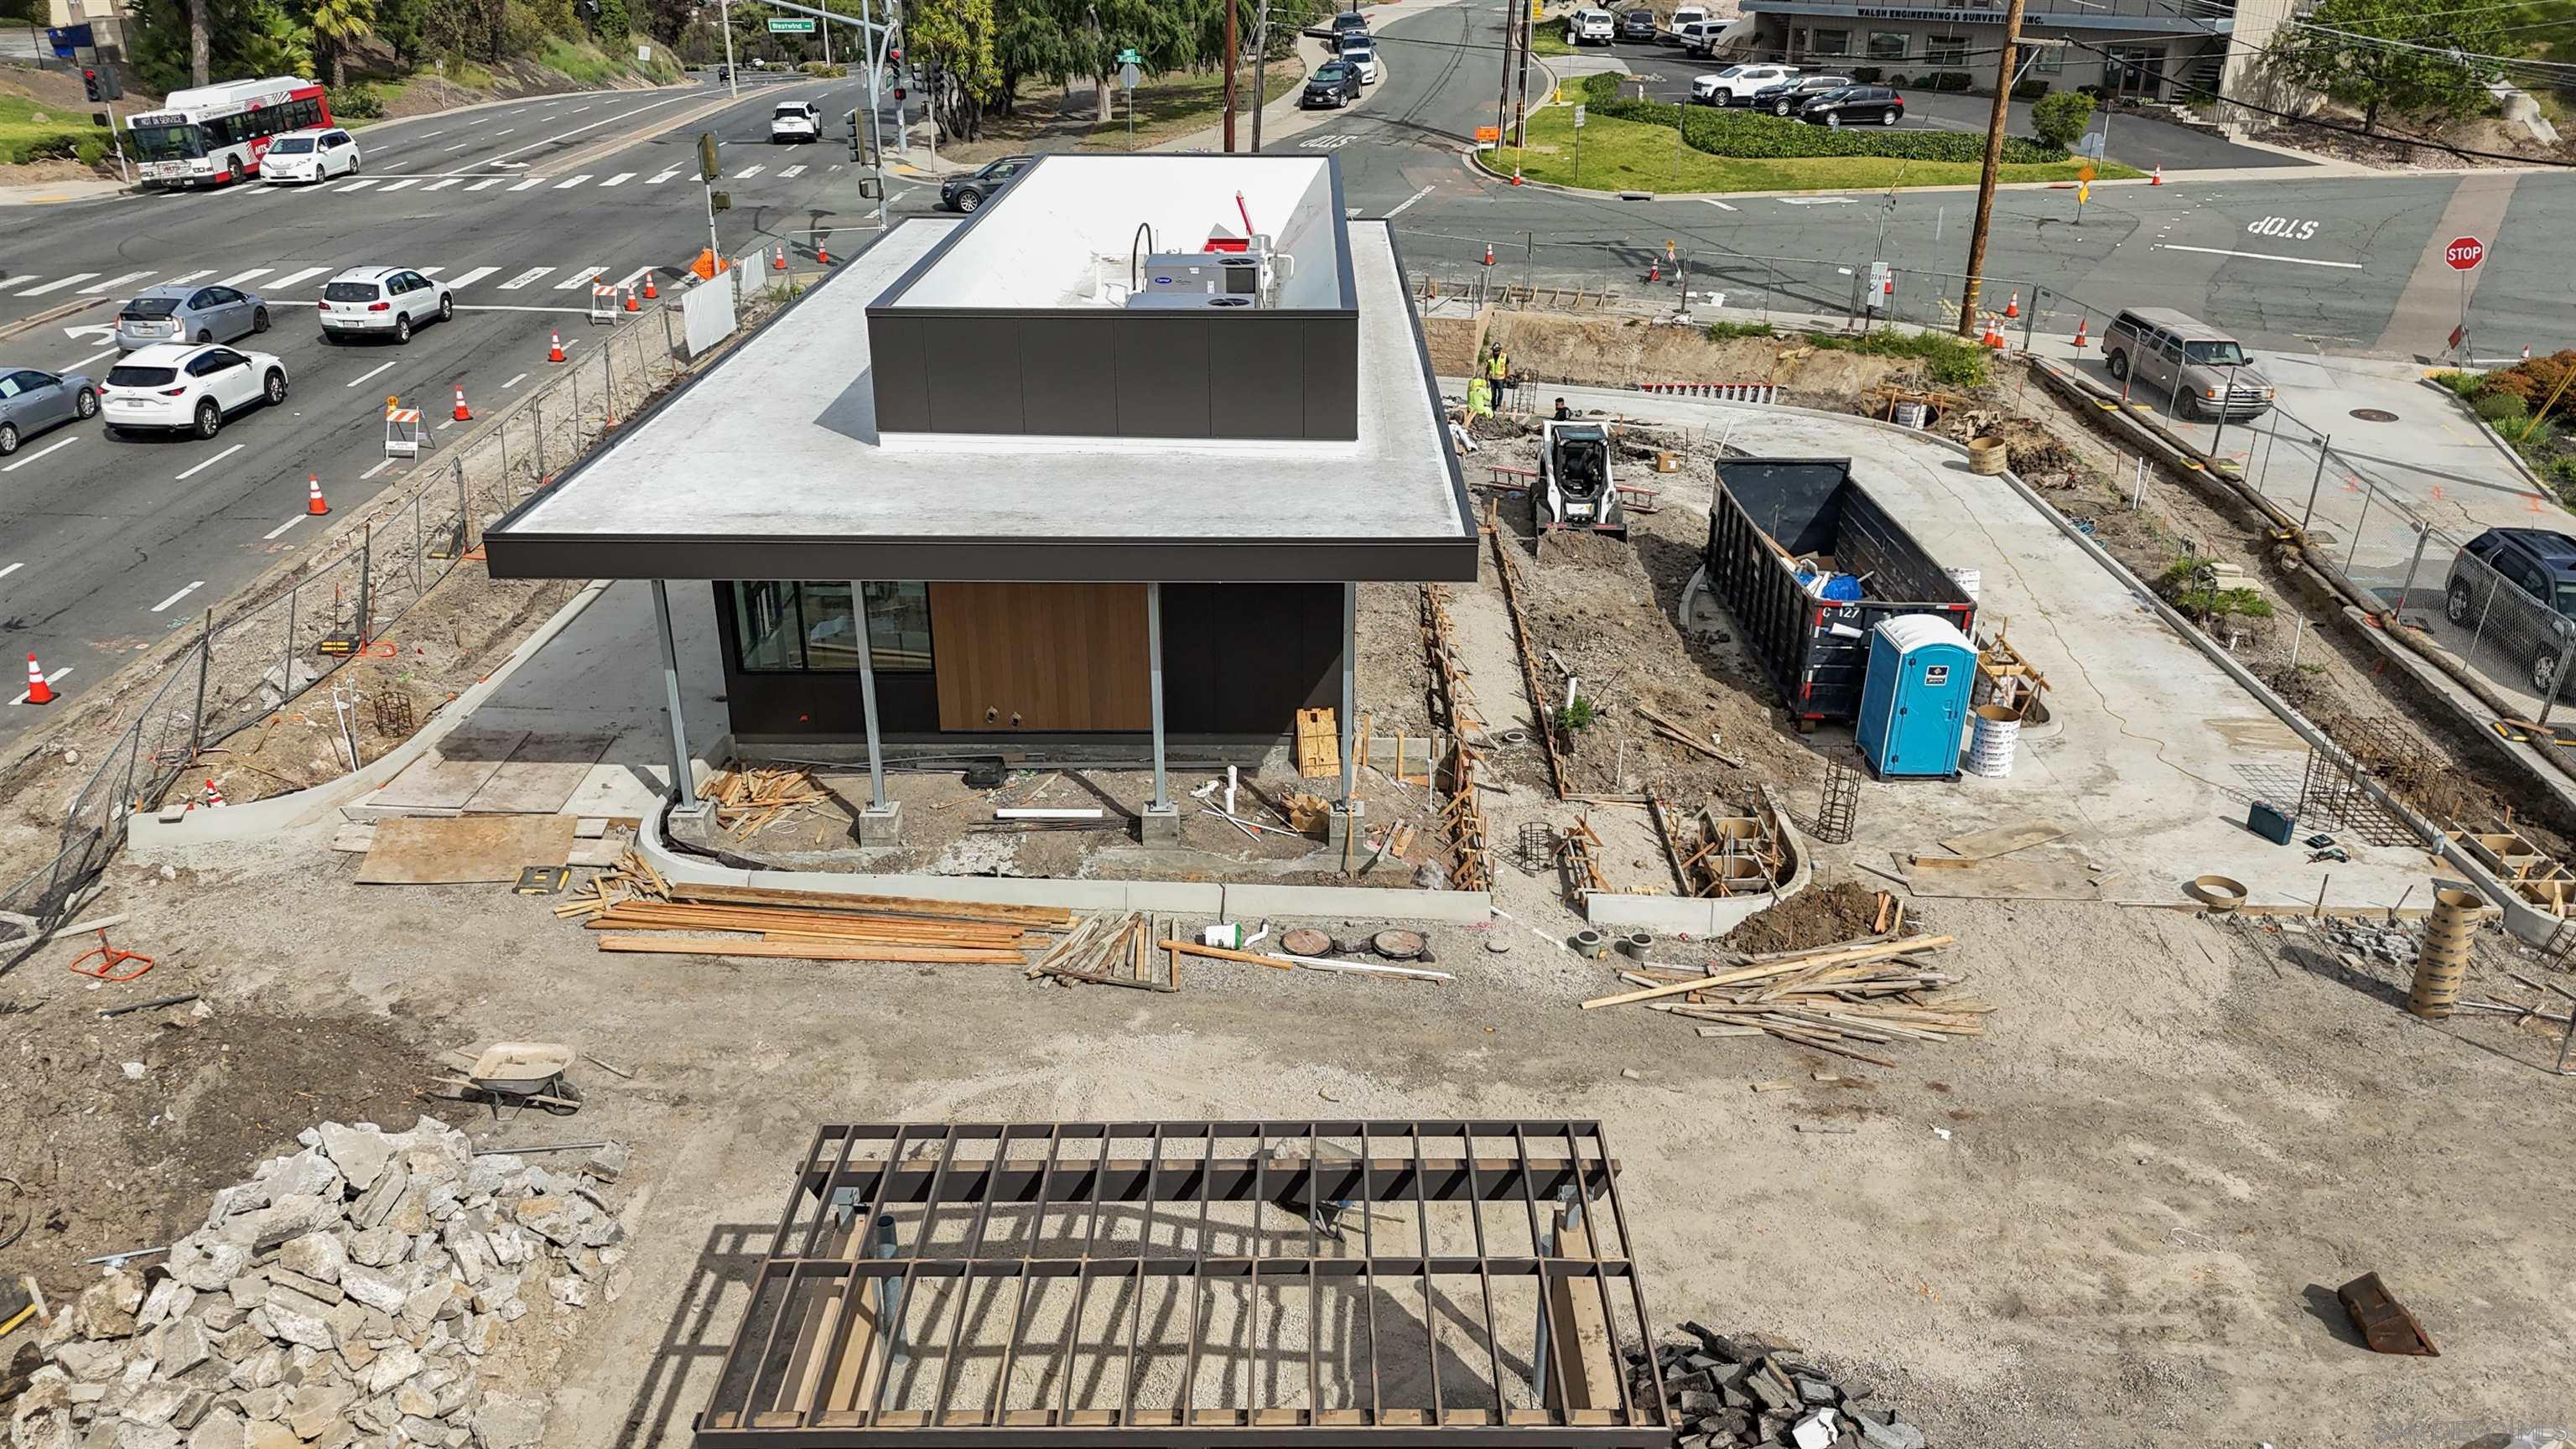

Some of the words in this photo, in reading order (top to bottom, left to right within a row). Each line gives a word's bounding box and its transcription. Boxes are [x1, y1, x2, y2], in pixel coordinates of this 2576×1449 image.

[1857, 8, 1887, 17] WALSH
[1889, 9, 1950, 20] ENGINEERING
[1962, 13, 2008, 23] SURVEYI
[2023, 15, 2044, 24] INC.
[2246, 216, 2320, 241] STOP
[2448, 246, 2482, 261] STOP
[1822, 606, 1831, 618] C
[1838, 606, 1860, 619] 127
